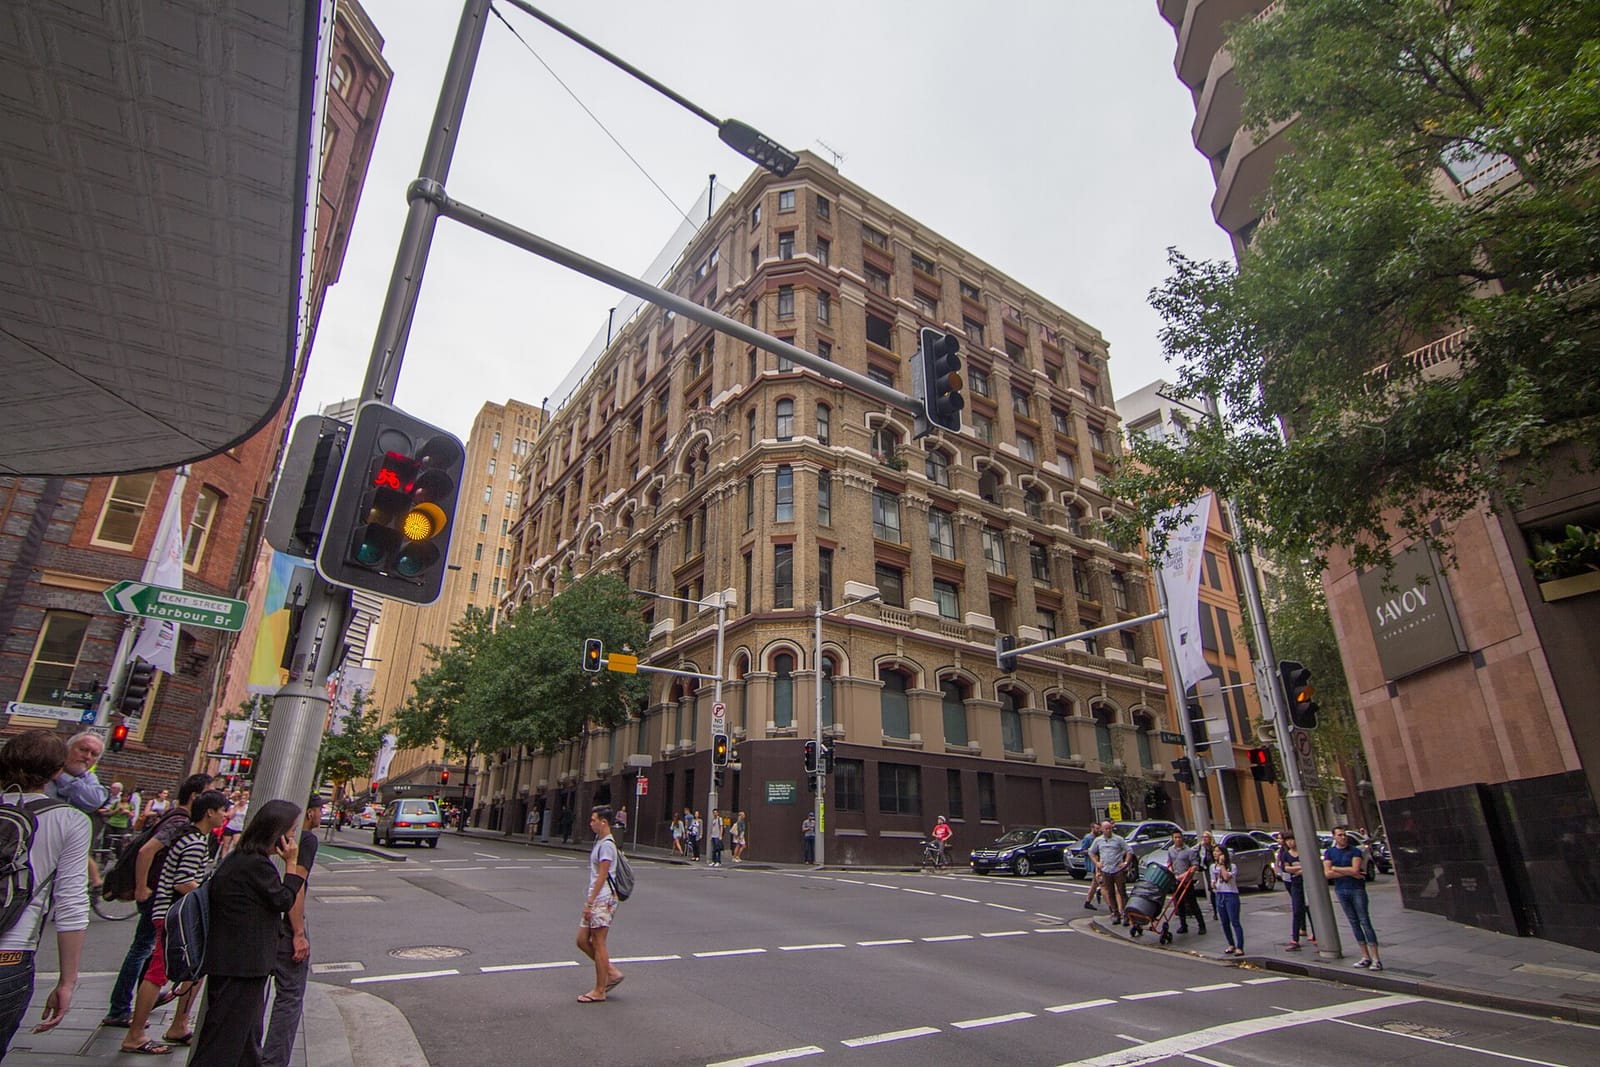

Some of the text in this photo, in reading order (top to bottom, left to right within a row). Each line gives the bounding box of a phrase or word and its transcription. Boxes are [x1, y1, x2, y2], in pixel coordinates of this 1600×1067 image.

[161, 593, 229, 612] KENT STREET
[1376, 584, 1427, 626] SAVOY
[146, 603, 232, 626] Harbour Br
[63, 690, 82, 698] Kent
